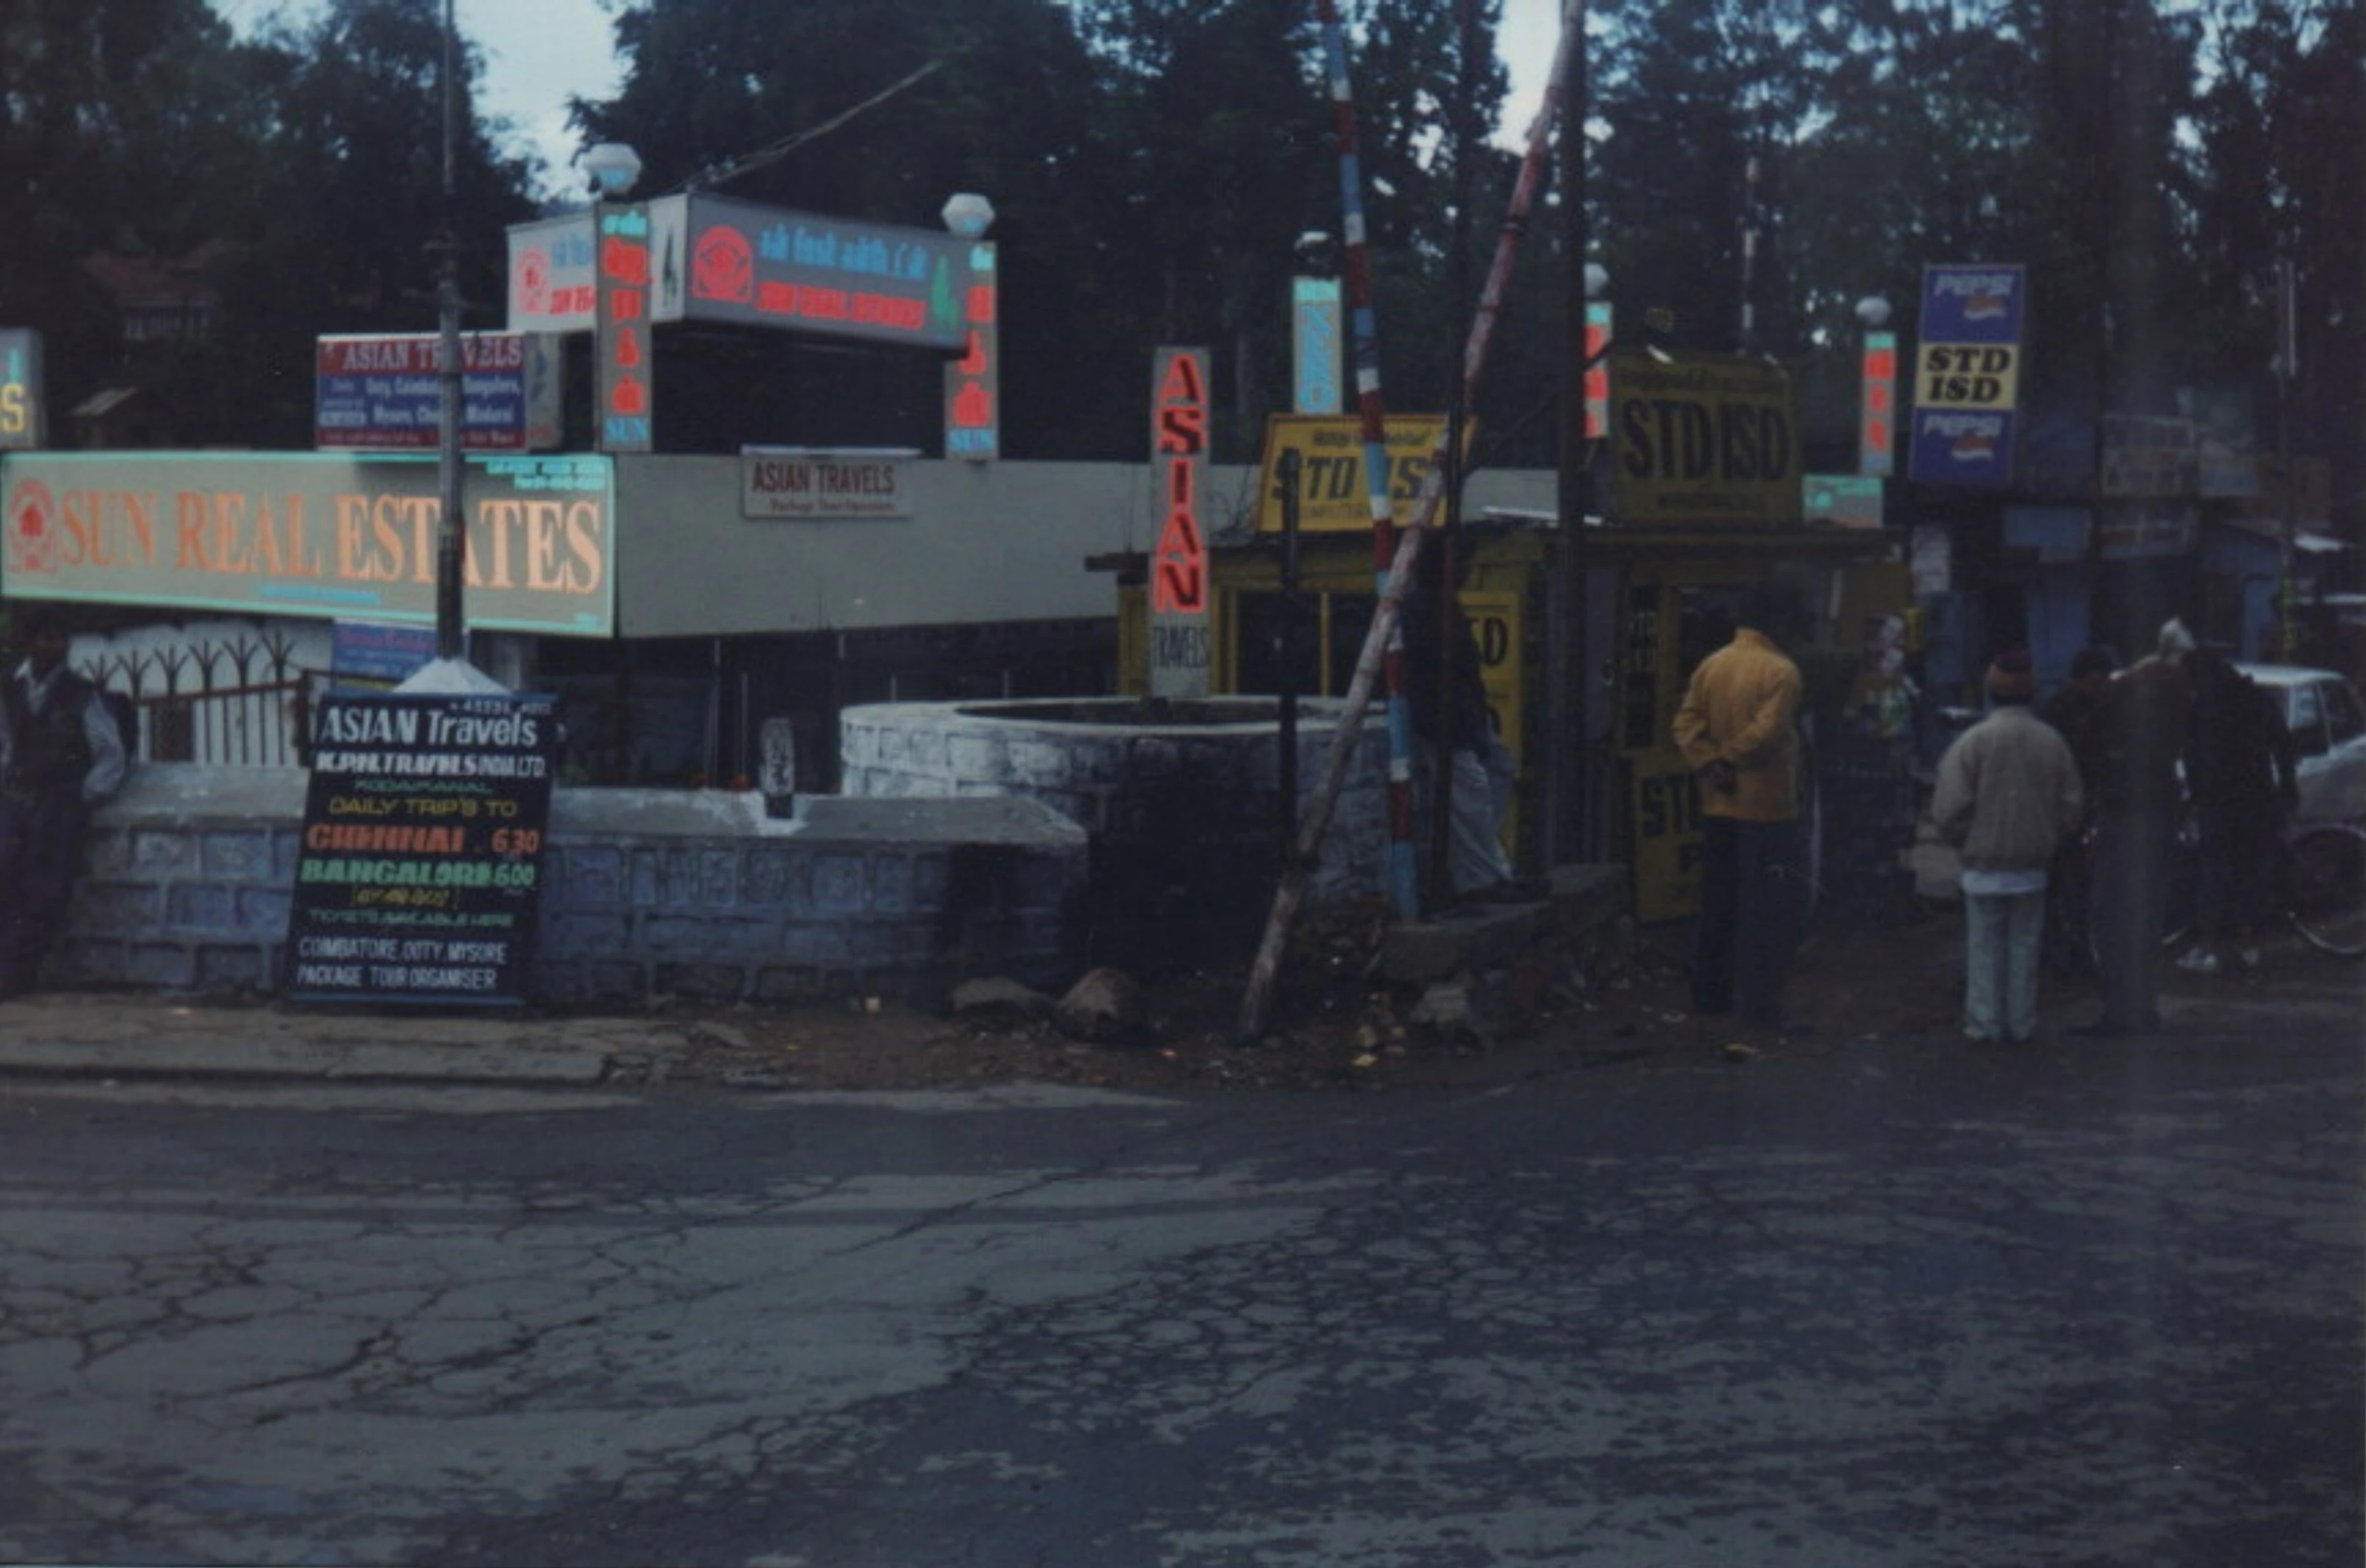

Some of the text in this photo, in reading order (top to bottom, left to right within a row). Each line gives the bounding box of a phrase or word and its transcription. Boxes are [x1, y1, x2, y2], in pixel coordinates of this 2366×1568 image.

[1934, 274, 2014, 296] PEPSI
[344, 343, 409, 370] ASIAN
[1926, 346, 2011, 373] STD
[1928, 375, 2002, 402] ISD
[1924, 413, 2003, 436] PEPSI
[1623, 398, 1788, 481] STD ISD
[752, 461, 894, 494] ASIAN TRAVELS
[1155, 352, 1209, 614] ASIAN
[61, 488, 159, 569] SUN
[174, 491, 323, 579] REAL
[321, 705, 539, 748] ASIAN Travels
[329, 797, 397, 815] DAILY
[486, 799, 519, 817] TO
